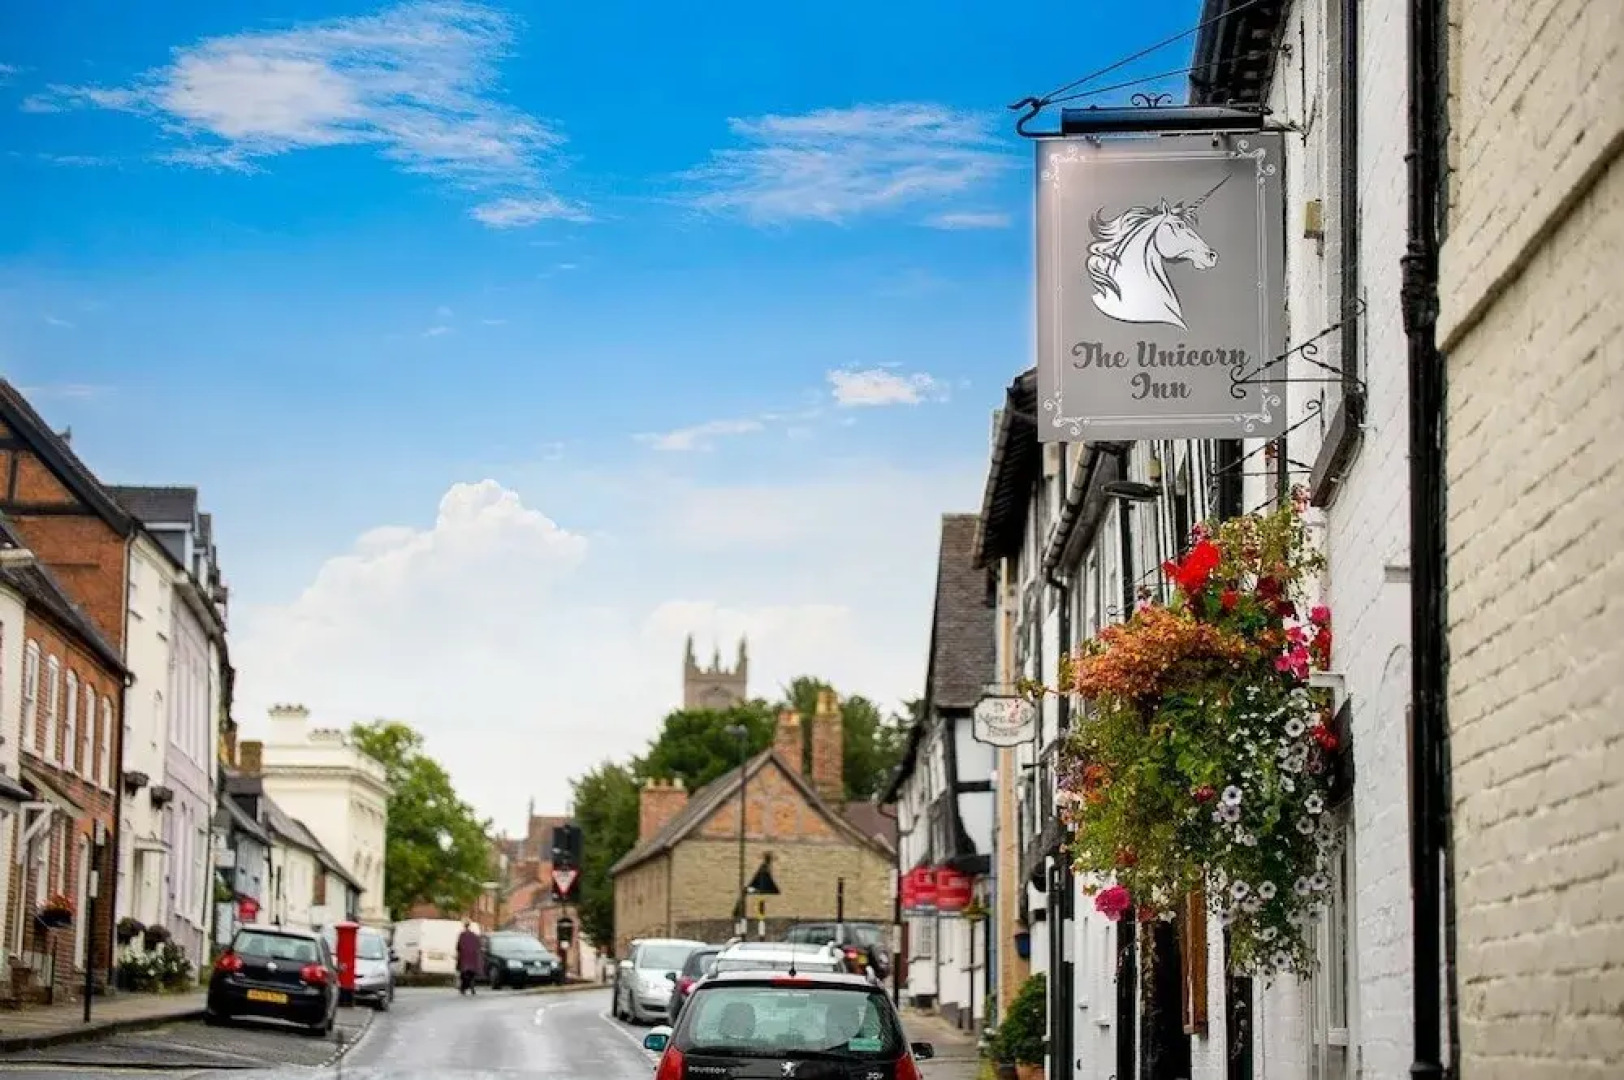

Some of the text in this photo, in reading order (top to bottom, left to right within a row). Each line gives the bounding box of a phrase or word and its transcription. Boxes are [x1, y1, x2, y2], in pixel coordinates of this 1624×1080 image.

[1072, 340, 1250, 368] The Unicorn
[1131, 372, 1192, 399] Inn
